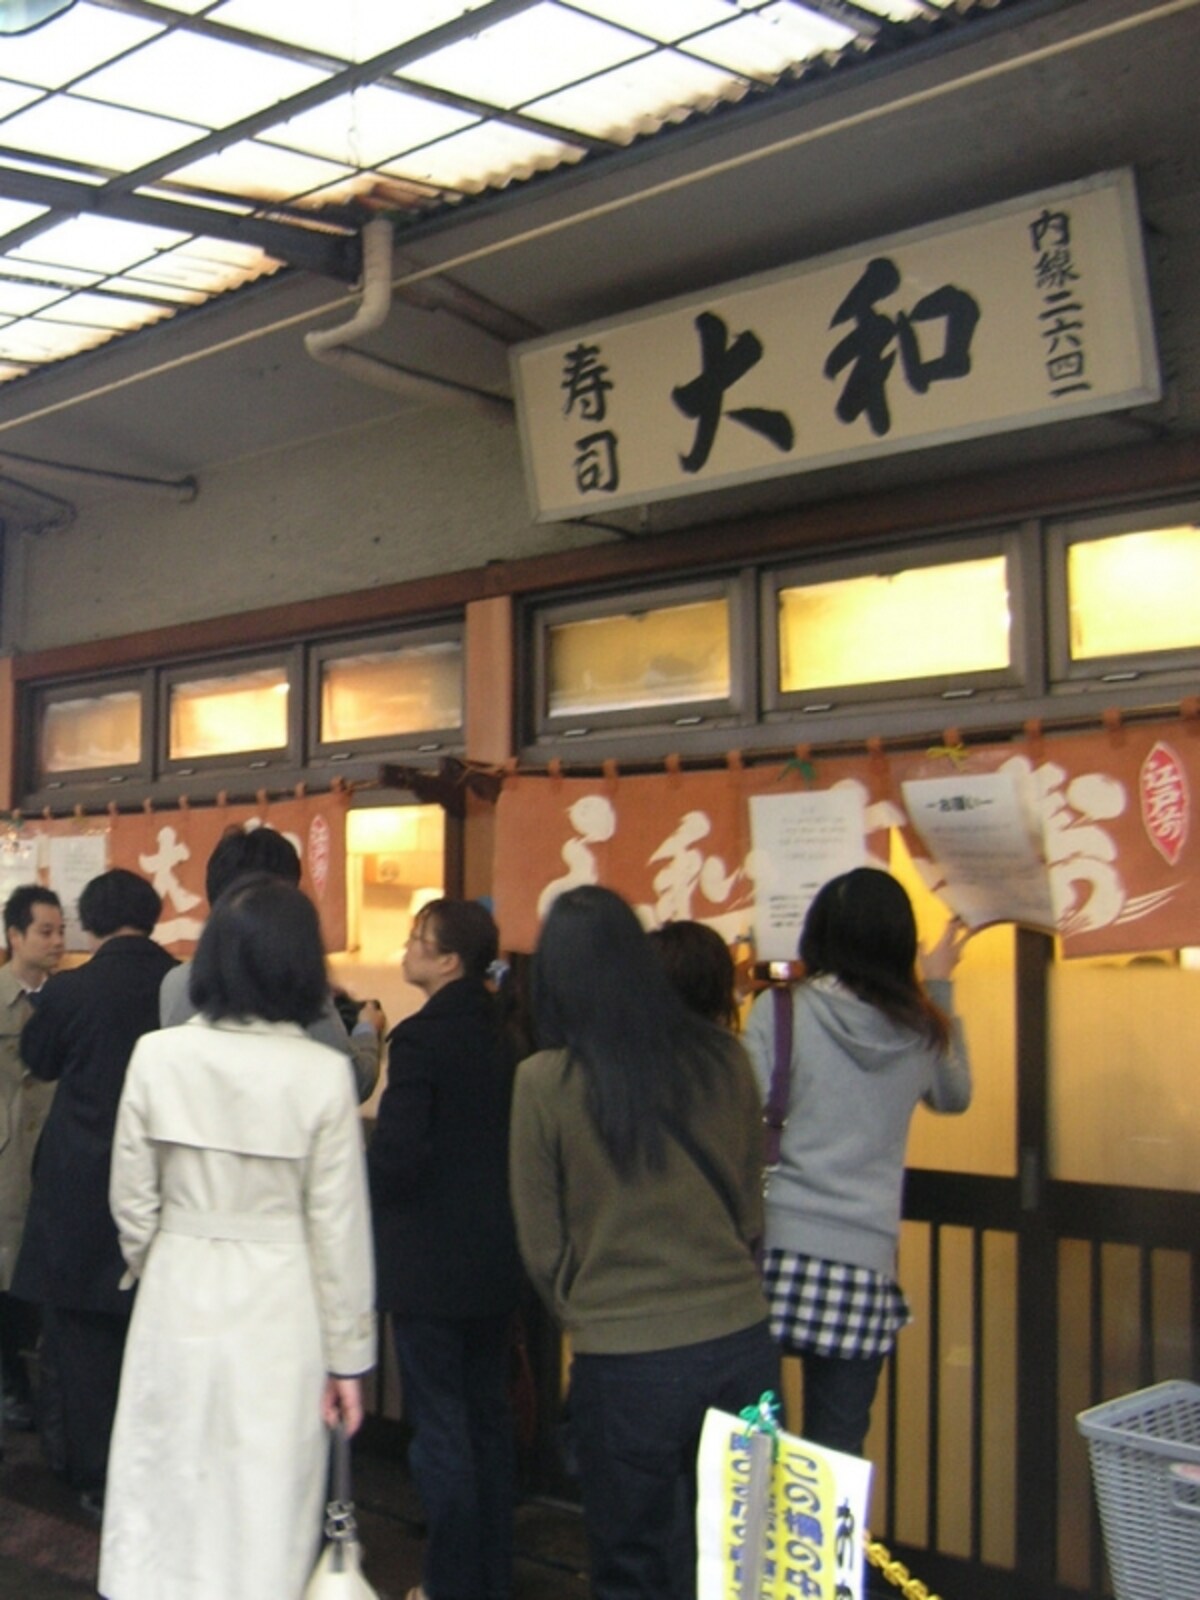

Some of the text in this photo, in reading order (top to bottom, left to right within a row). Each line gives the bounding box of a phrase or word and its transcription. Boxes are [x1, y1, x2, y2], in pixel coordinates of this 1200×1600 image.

[671, 257, 981, 474] 大和
[1028, 208, 1093, 398] 内線二六四一
[561, 341, 621, 495] 寿司
